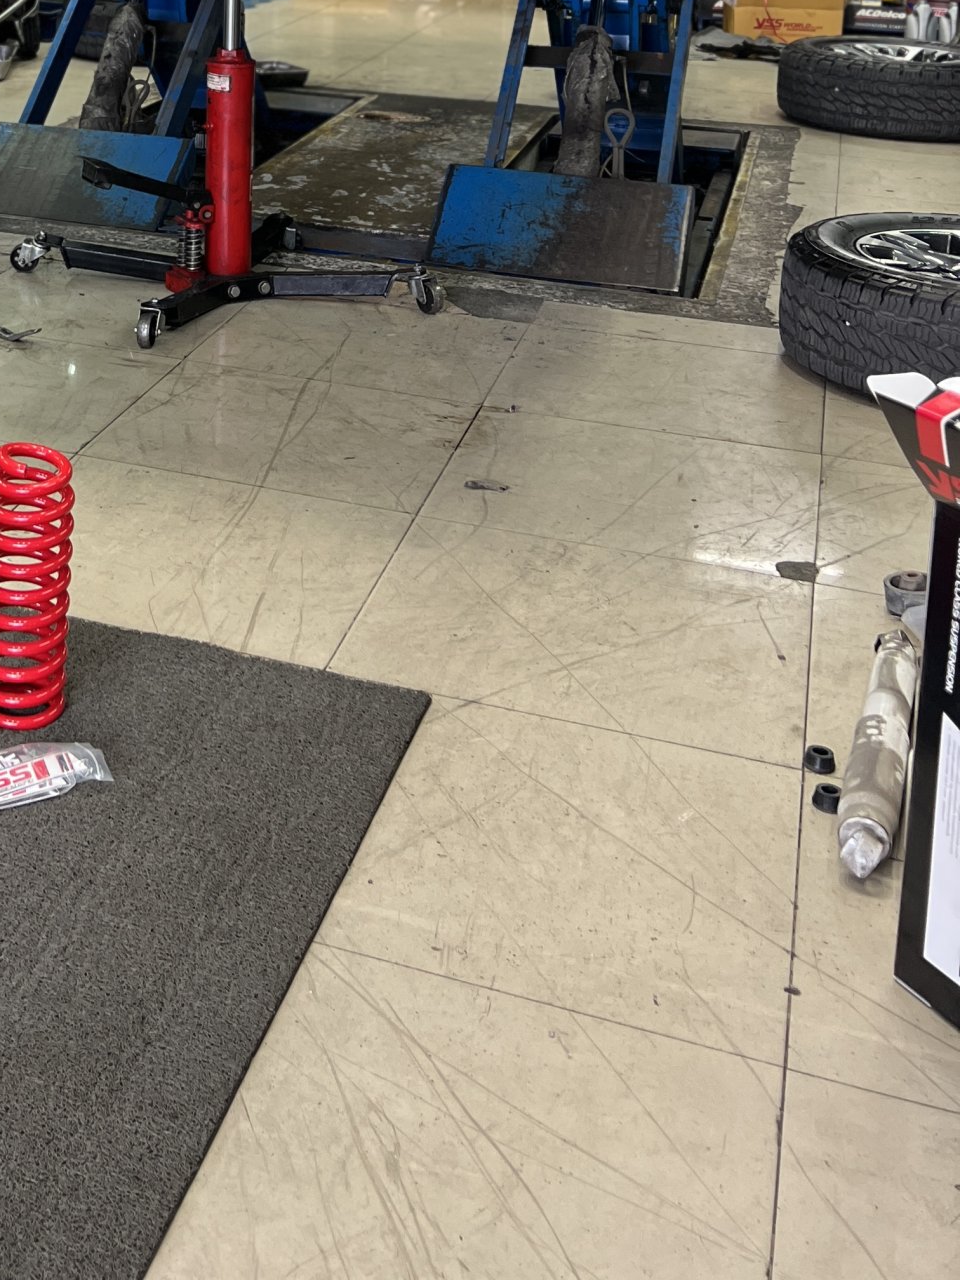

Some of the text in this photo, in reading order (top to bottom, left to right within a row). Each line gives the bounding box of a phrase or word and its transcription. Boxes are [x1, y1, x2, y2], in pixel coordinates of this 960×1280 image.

[856, 8, 907, 19] ACDelco
[753, 17, 785, 30] YSS
[945, 618, 959, 694] SUSPENSION
